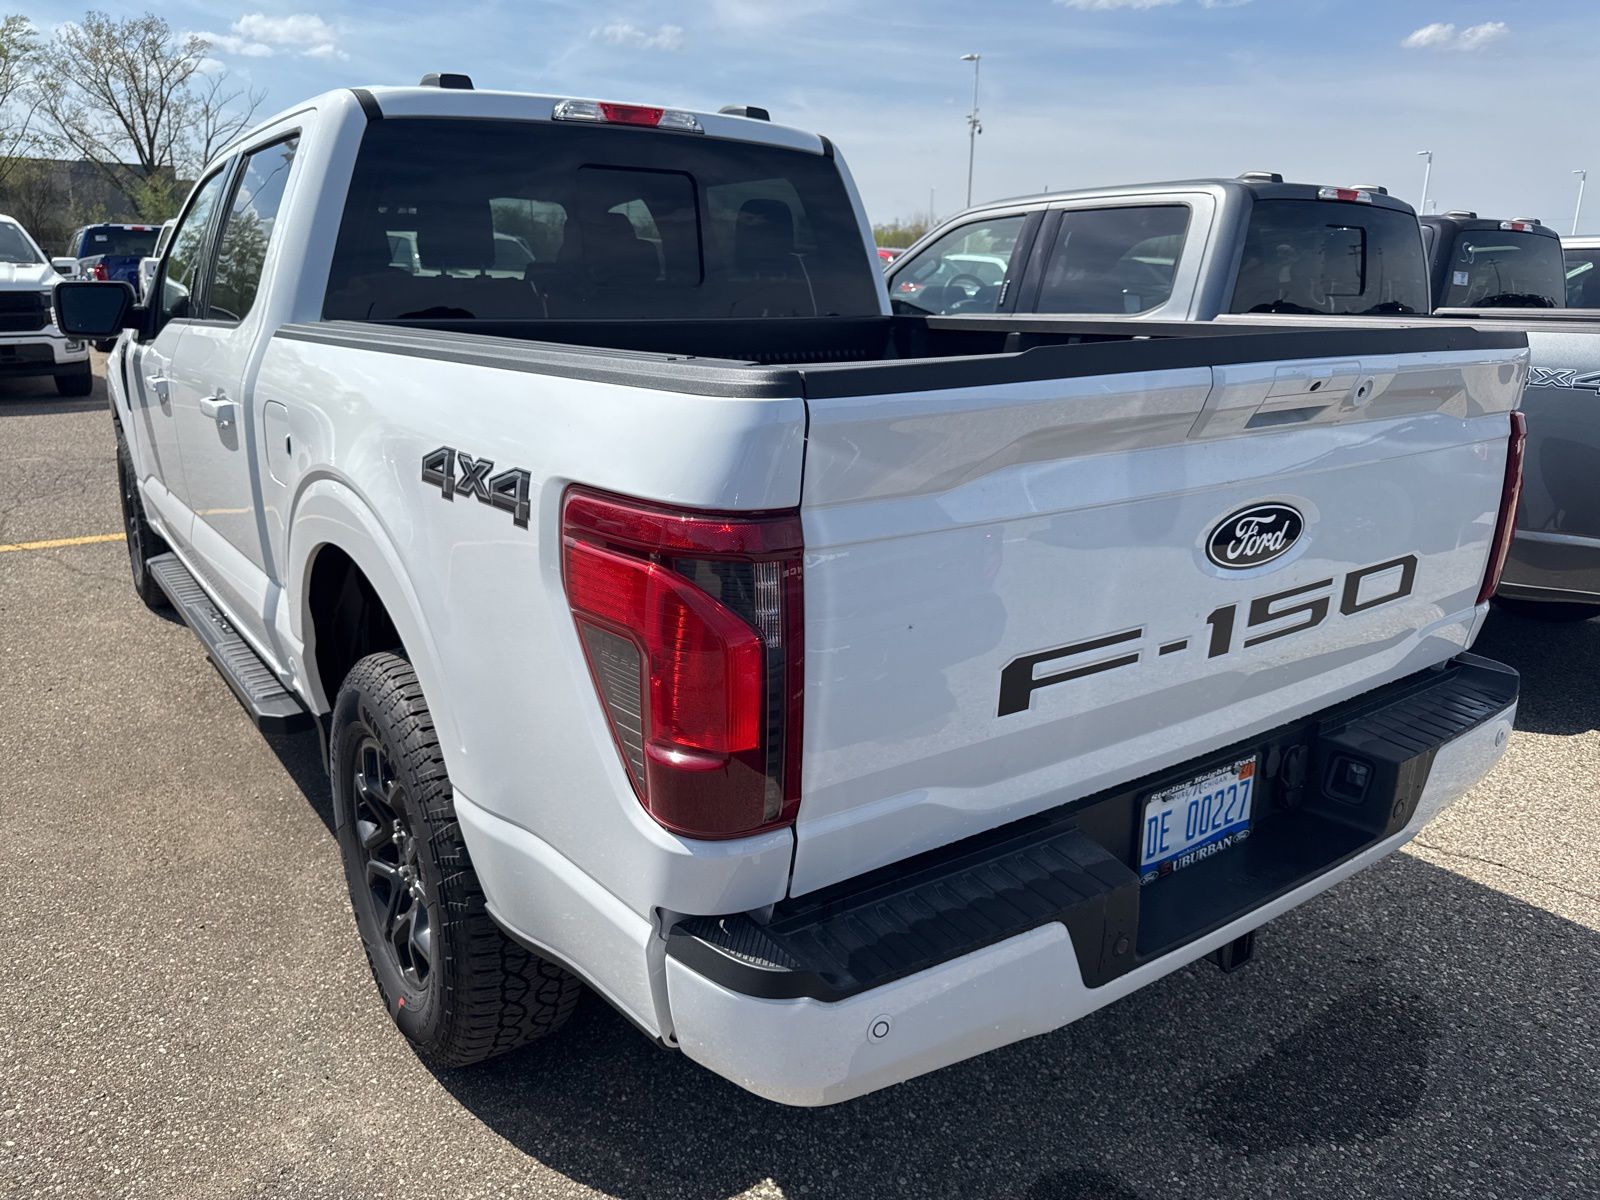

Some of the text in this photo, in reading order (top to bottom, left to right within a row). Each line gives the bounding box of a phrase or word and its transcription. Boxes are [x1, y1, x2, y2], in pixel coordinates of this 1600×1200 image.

[1226, 513, 1290, 560] Ford
[997, 553, 1419, 718] F-150
[1151, 781, 1191, 800] Sterling
[1194, 765, 1232, 784] Heights
[1234, 755, 1257, 768] Ford
[1147, 780, 1249, 859] DE 00227
